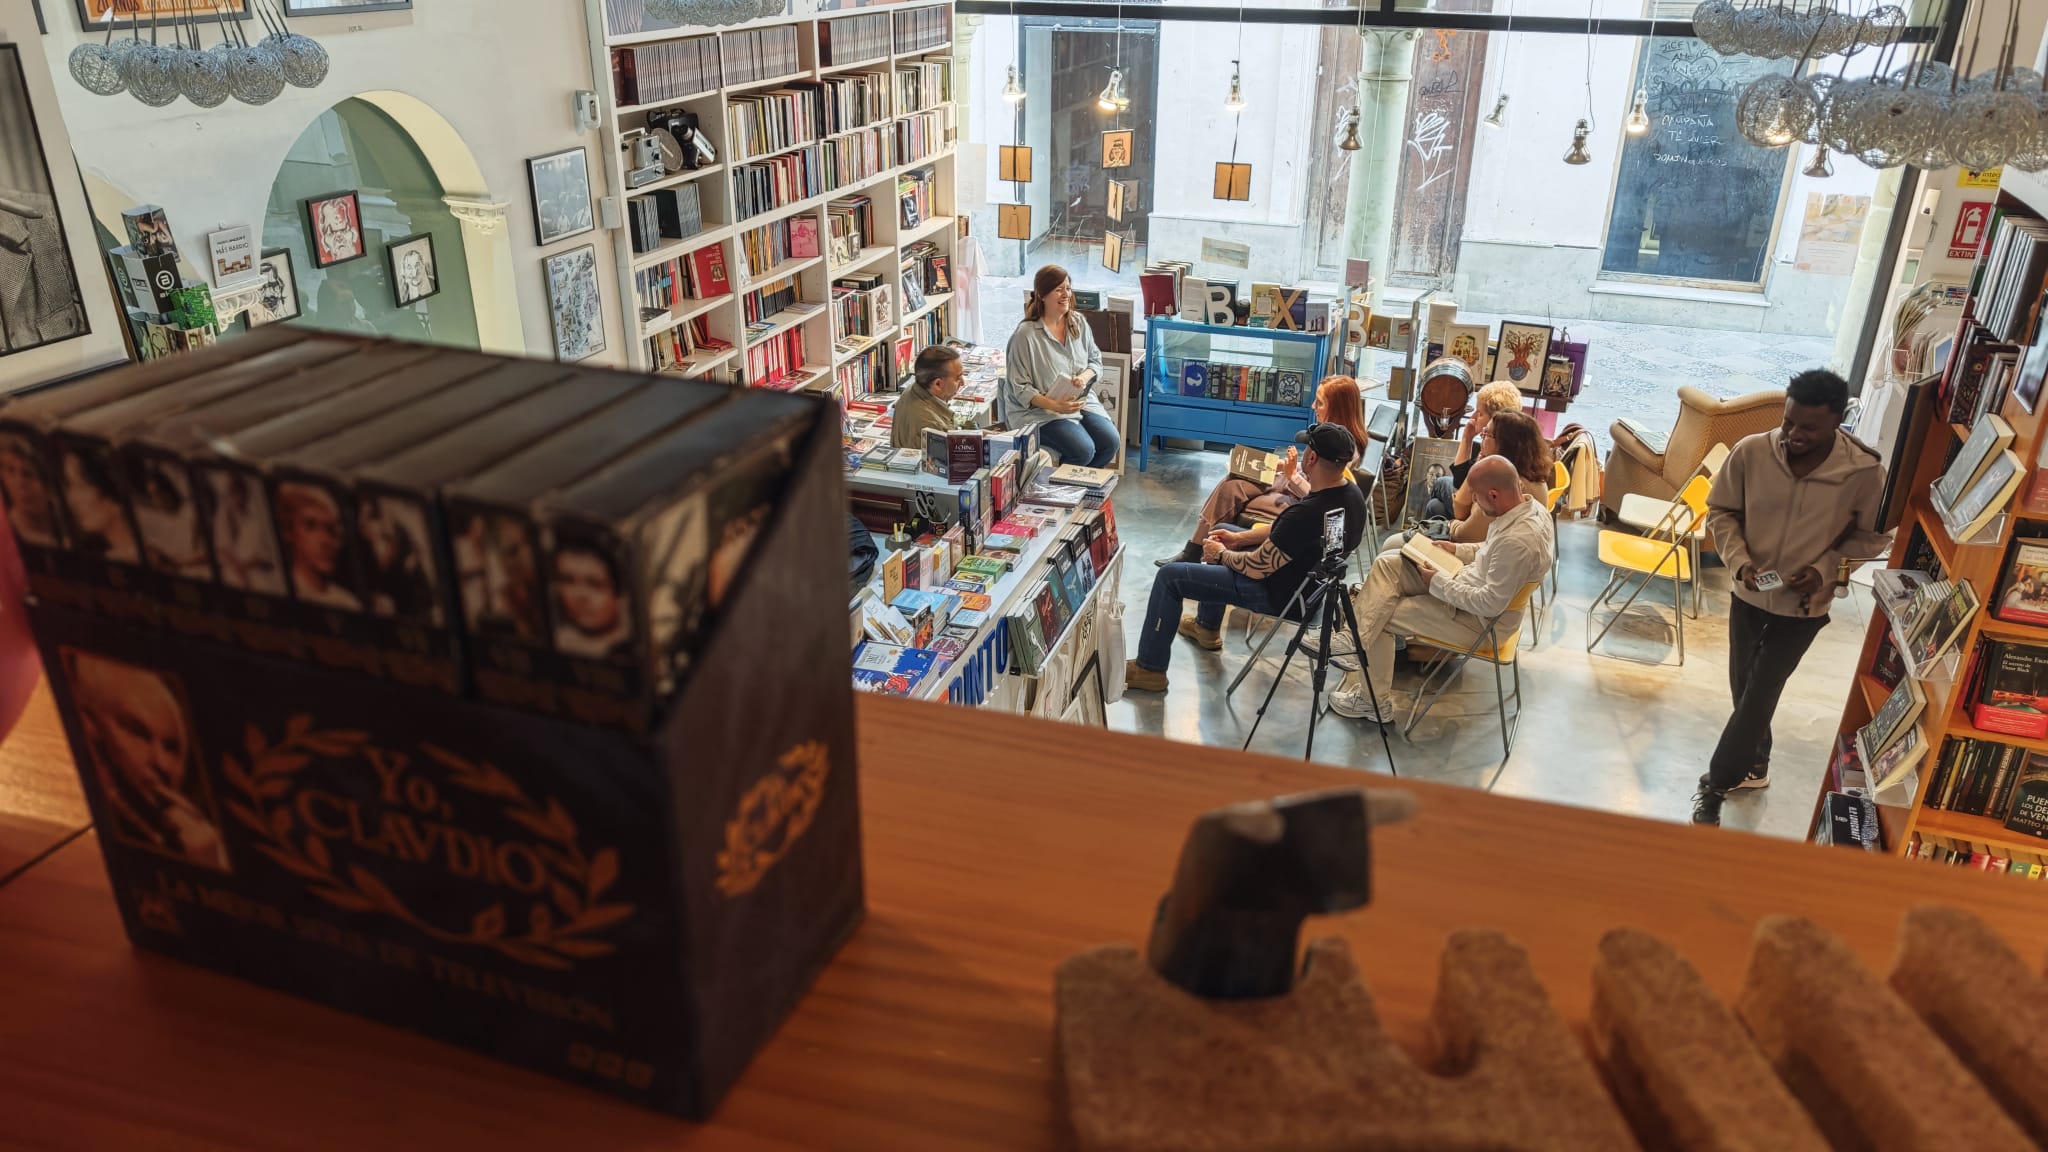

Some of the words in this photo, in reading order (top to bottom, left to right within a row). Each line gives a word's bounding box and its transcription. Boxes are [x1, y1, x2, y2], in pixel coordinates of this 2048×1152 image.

[1205, 285, 1235, 327] B
[1269, 287, 1301, 331] X
[2021, 802, 2033, 810] LOS
